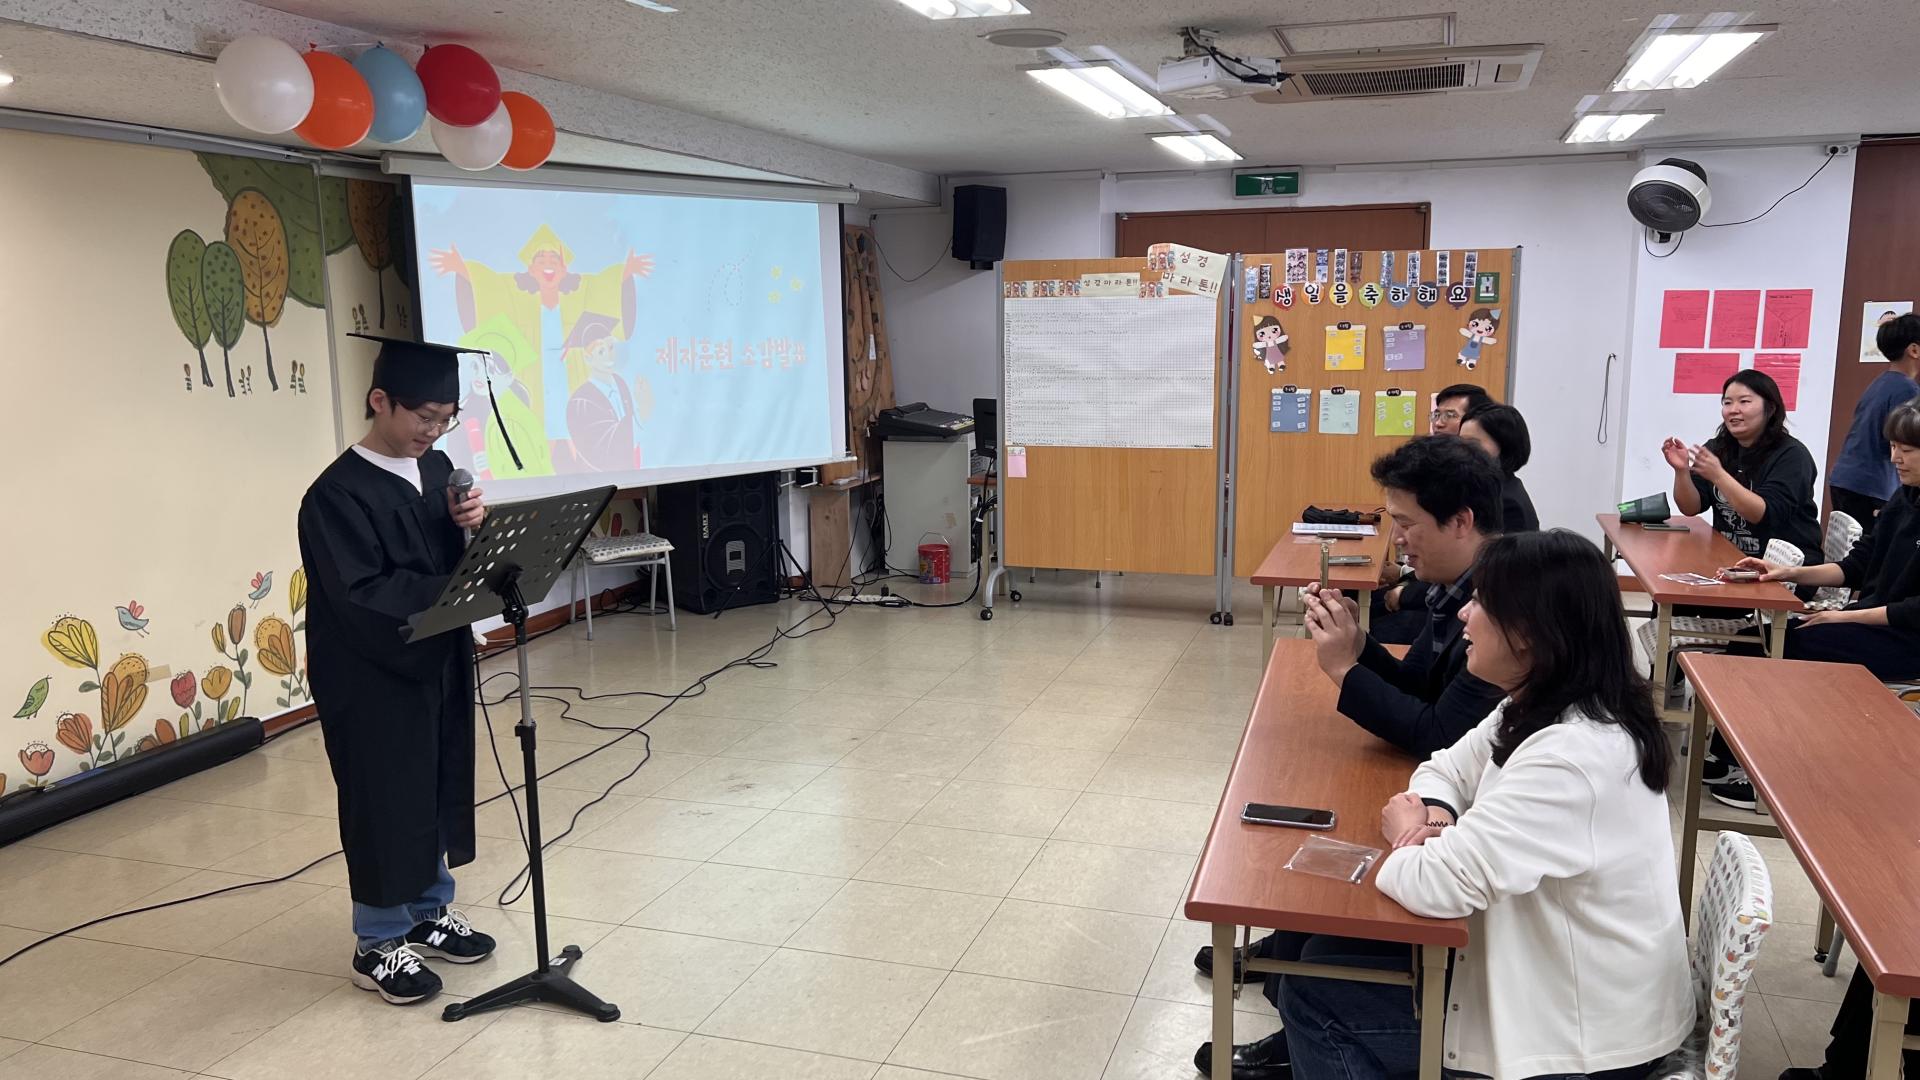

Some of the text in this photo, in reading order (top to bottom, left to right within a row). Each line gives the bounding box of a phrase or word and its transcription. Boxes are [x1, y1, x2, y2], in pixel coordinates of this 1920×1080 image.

[1180, 251, 1209, 268] 성경
[1162, 271, 1218, 294] 마라톤!!
[655, 336, 735, 373] 제자훈련
[426, 930, 447, 946] N
